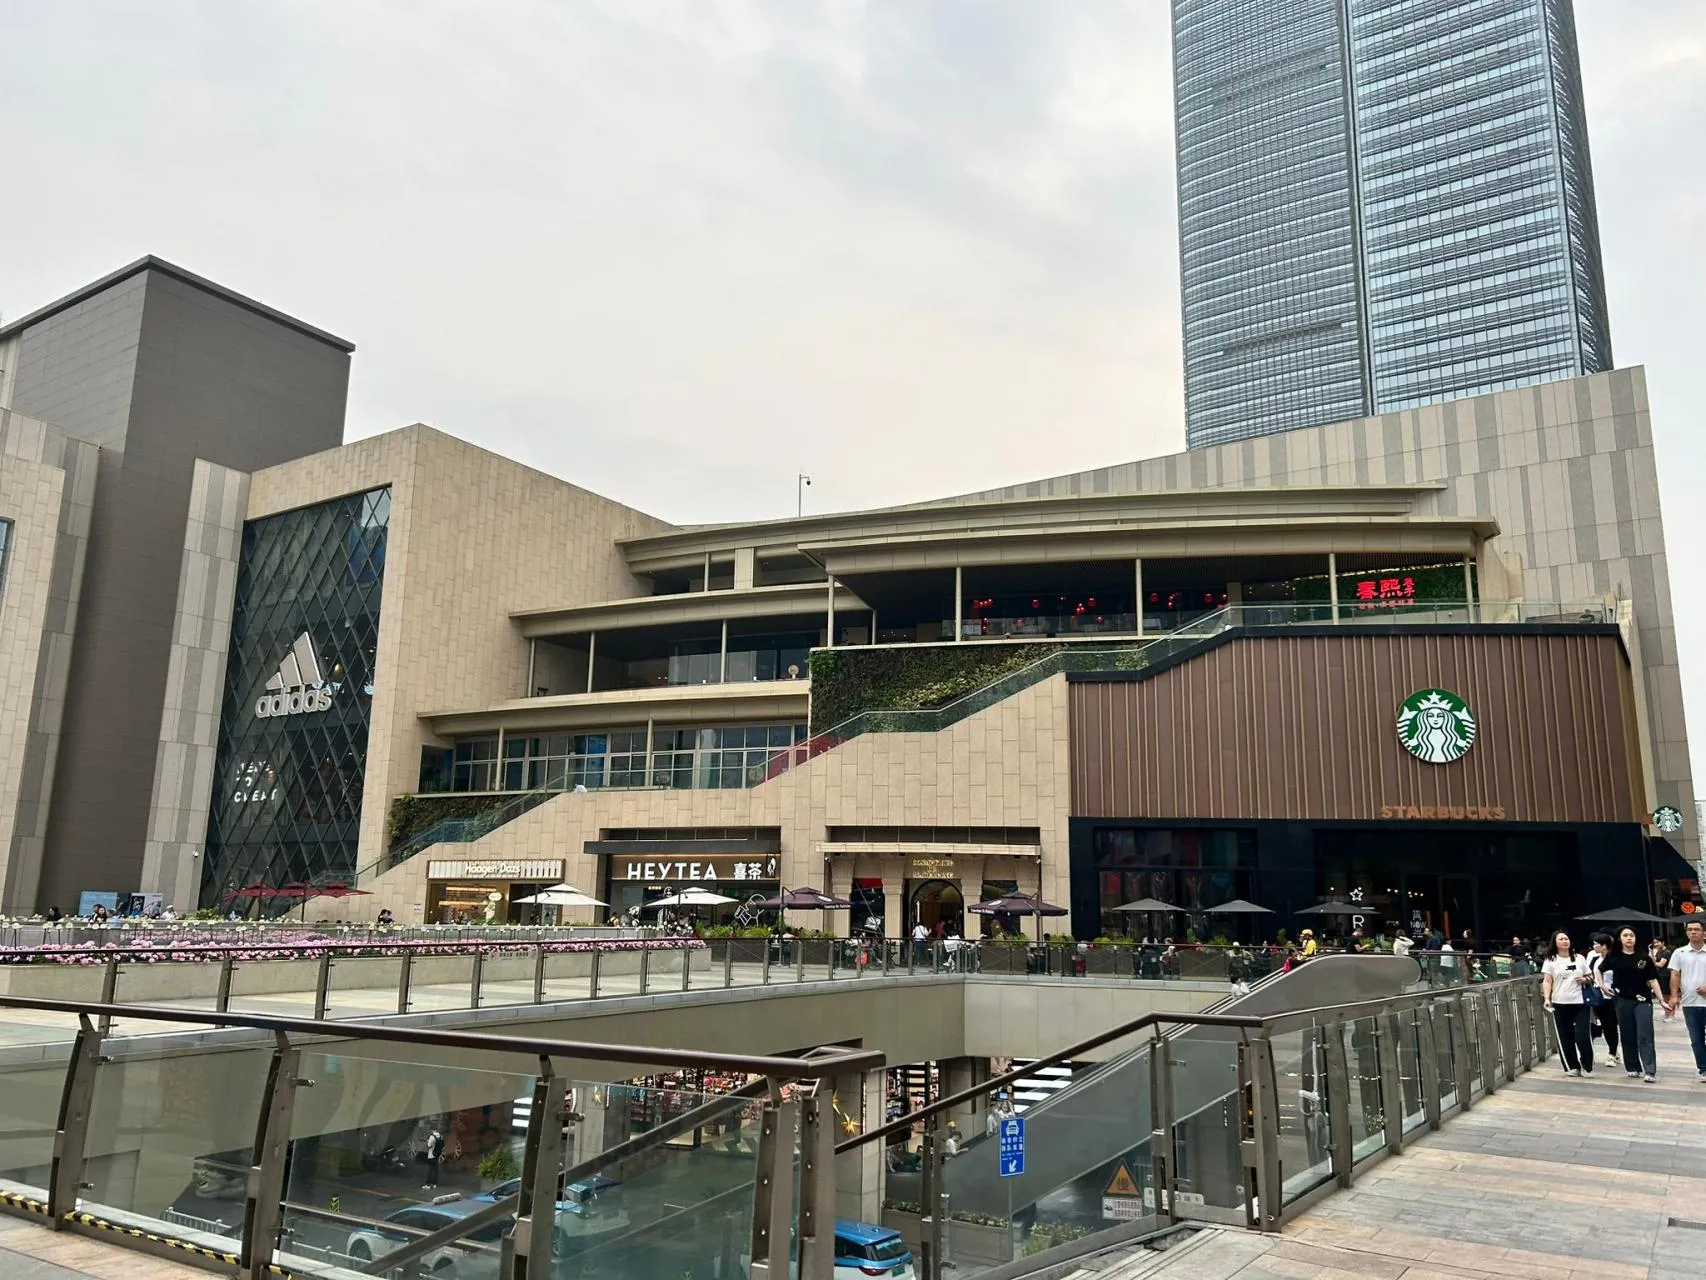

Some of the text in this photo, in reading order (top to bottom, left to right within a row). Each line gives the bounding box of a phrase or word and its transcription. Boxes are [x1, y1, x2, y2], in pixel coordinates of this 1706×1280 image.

[255, 683, 333, 718] adidas
[1381, 805, 1505, 819] STARBUCKS
[627, 862, 762, 880] HEYTEA 喜茶
